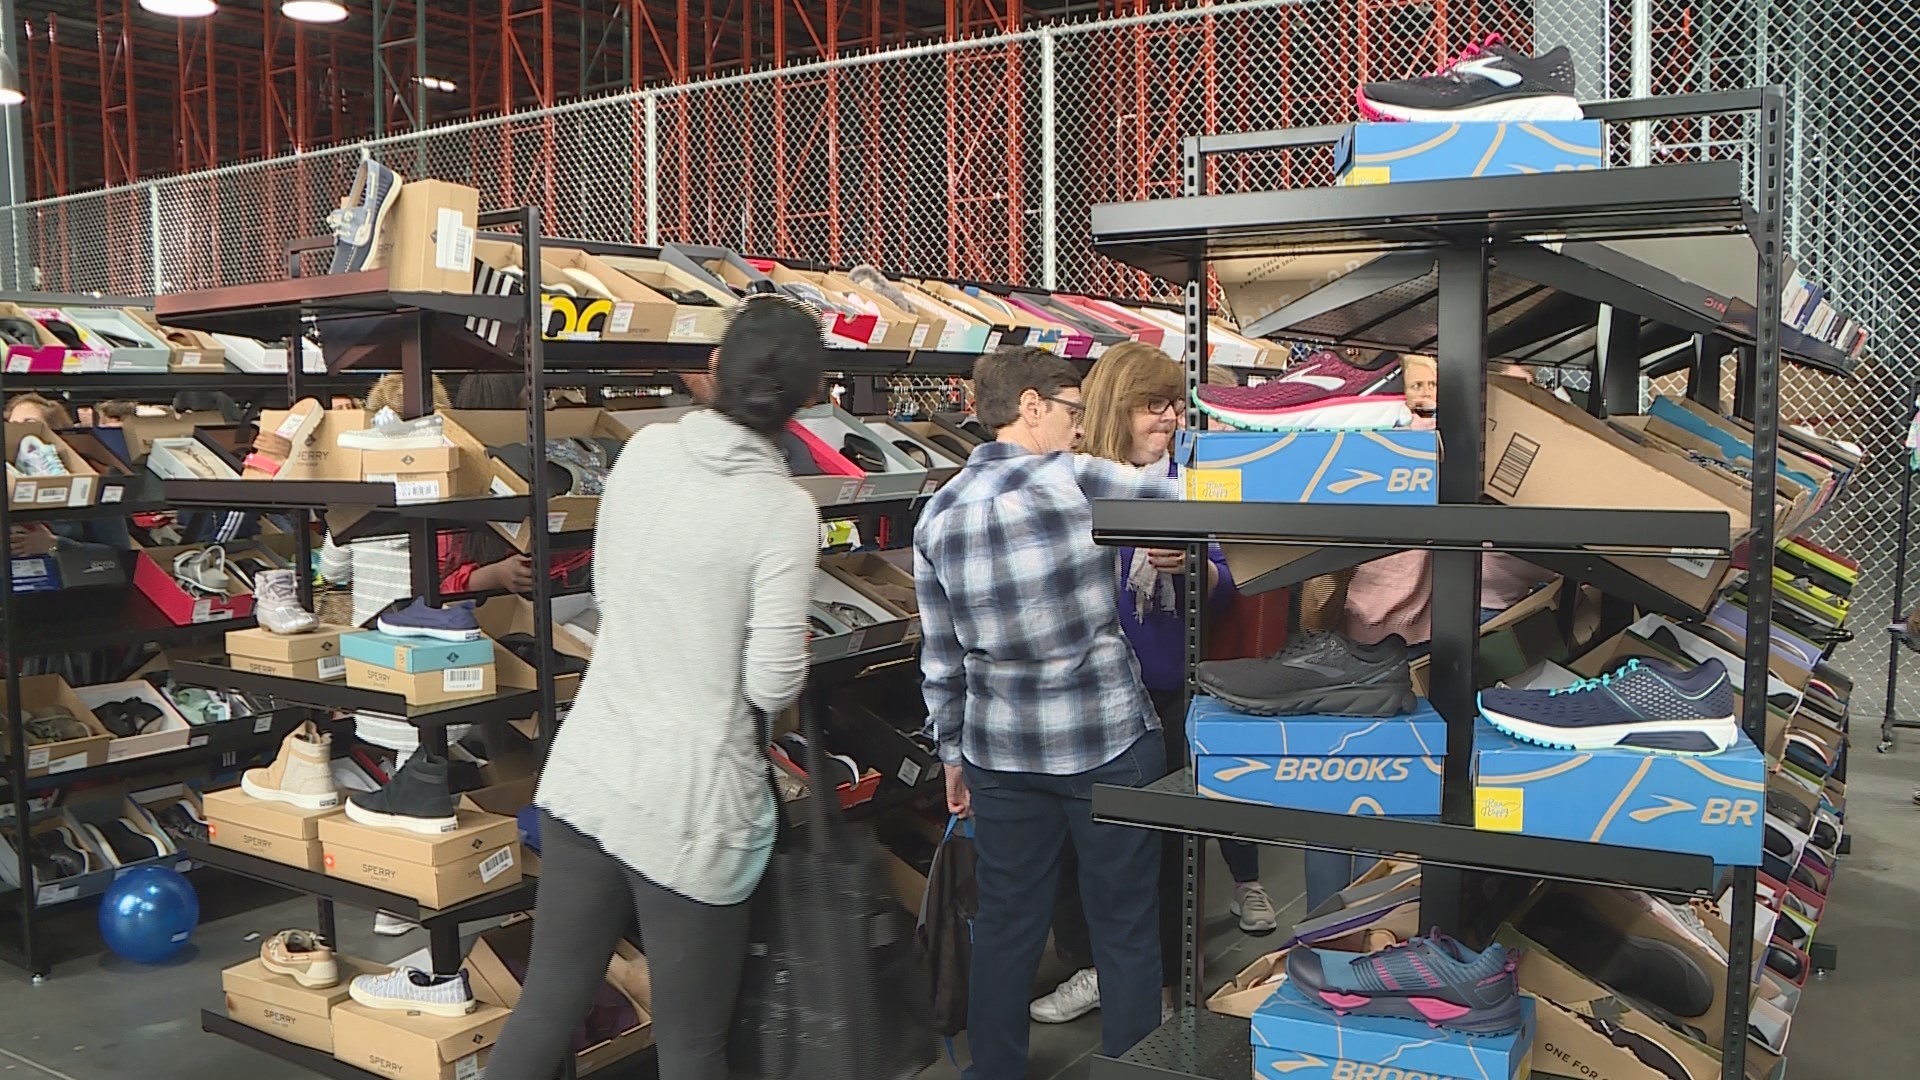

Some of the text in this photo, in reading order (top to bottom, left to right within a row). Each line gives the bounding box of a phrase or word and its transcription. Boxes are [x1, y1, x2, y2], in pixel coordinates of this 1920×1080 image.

[1386, 468, 1433, 493] BR
[367, 670, 391, 682] SPERRY
[1274, 757, 1414, 782] BROOKS
[1700, 798, 1759, 826] BR
[243, 834, 272, 848] SPERRY
[362, 863, 396, 879] SPERRY
[263, 1008, 297, 1025] SPERRY
[369, 1054, 403, 1073] SPERRY
[1544, 1042, 1599, 1080] ONE FOR
